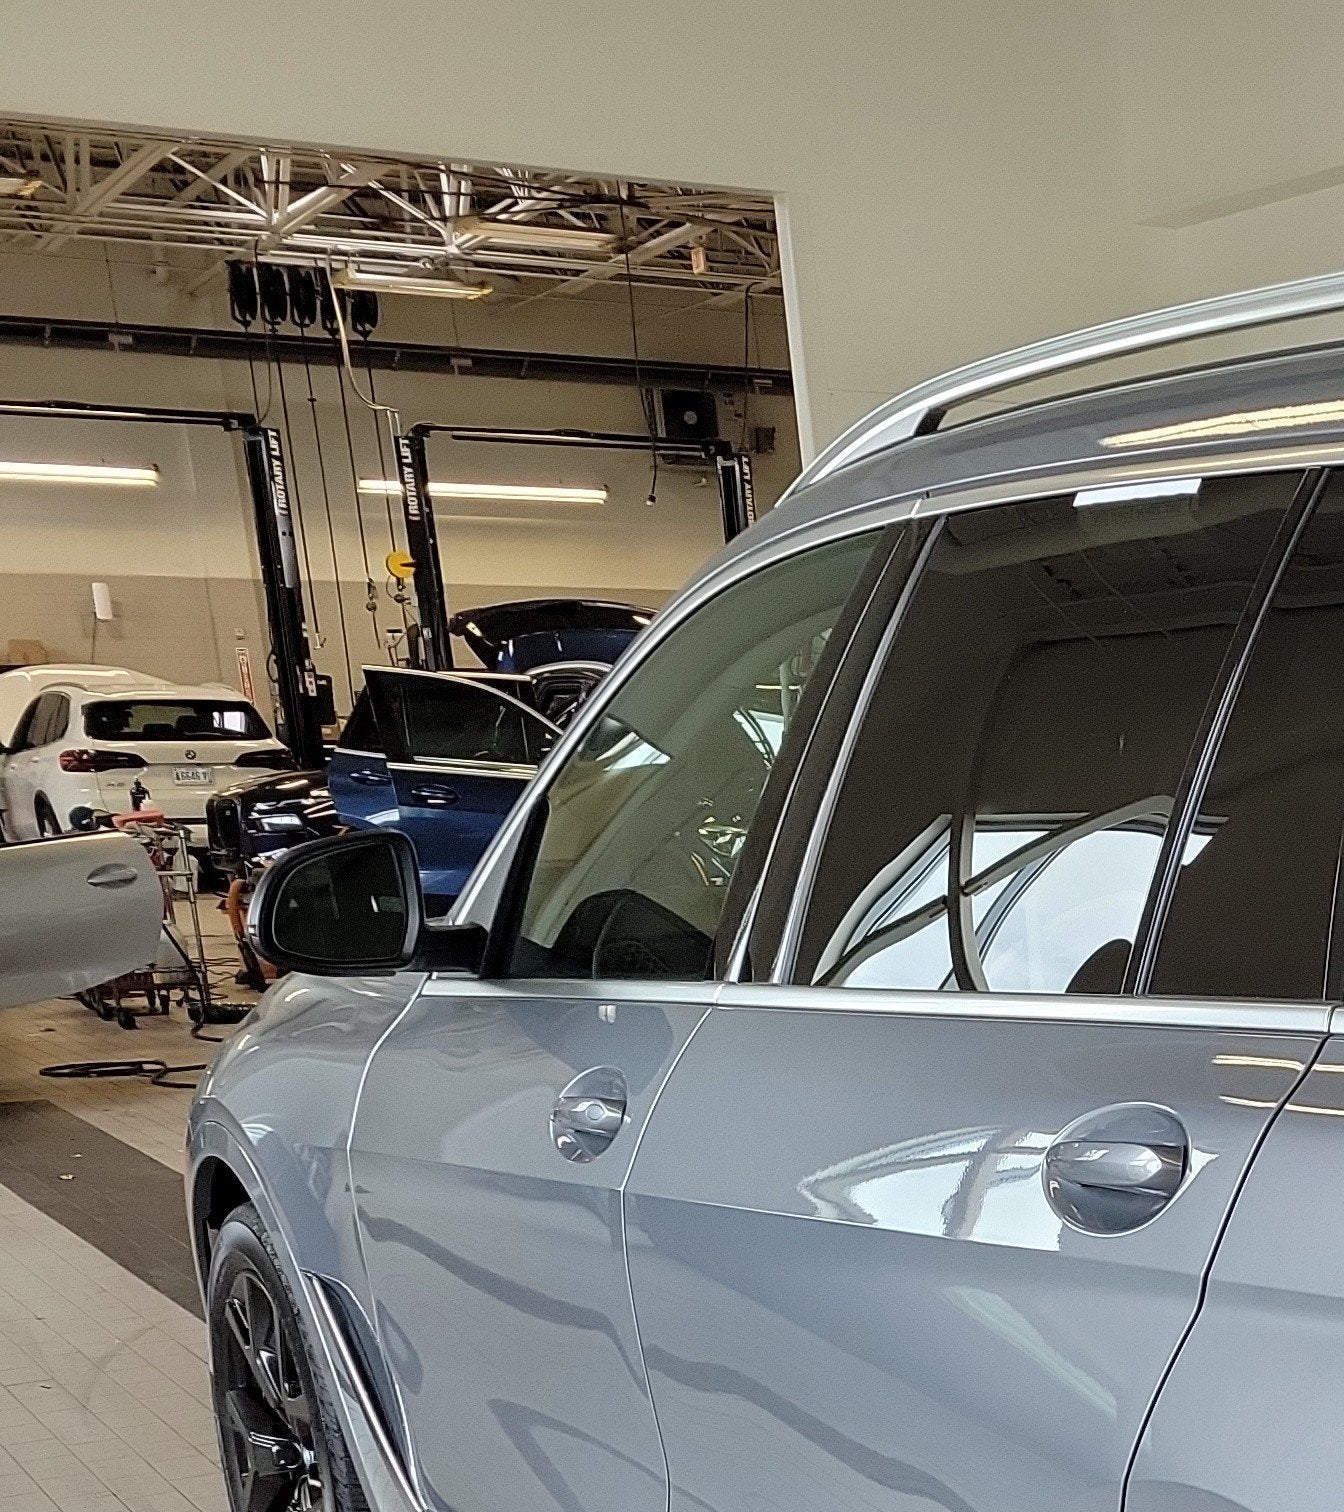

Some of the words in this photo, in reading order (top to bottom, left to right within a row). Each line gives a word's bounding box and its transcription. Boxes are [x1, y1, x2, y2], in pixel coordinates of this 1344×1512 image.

[268, 429, 281, 456] LIFT
[400, 438, 413, 463] LIFT
[402, 465, 421, 515] ROTARY
